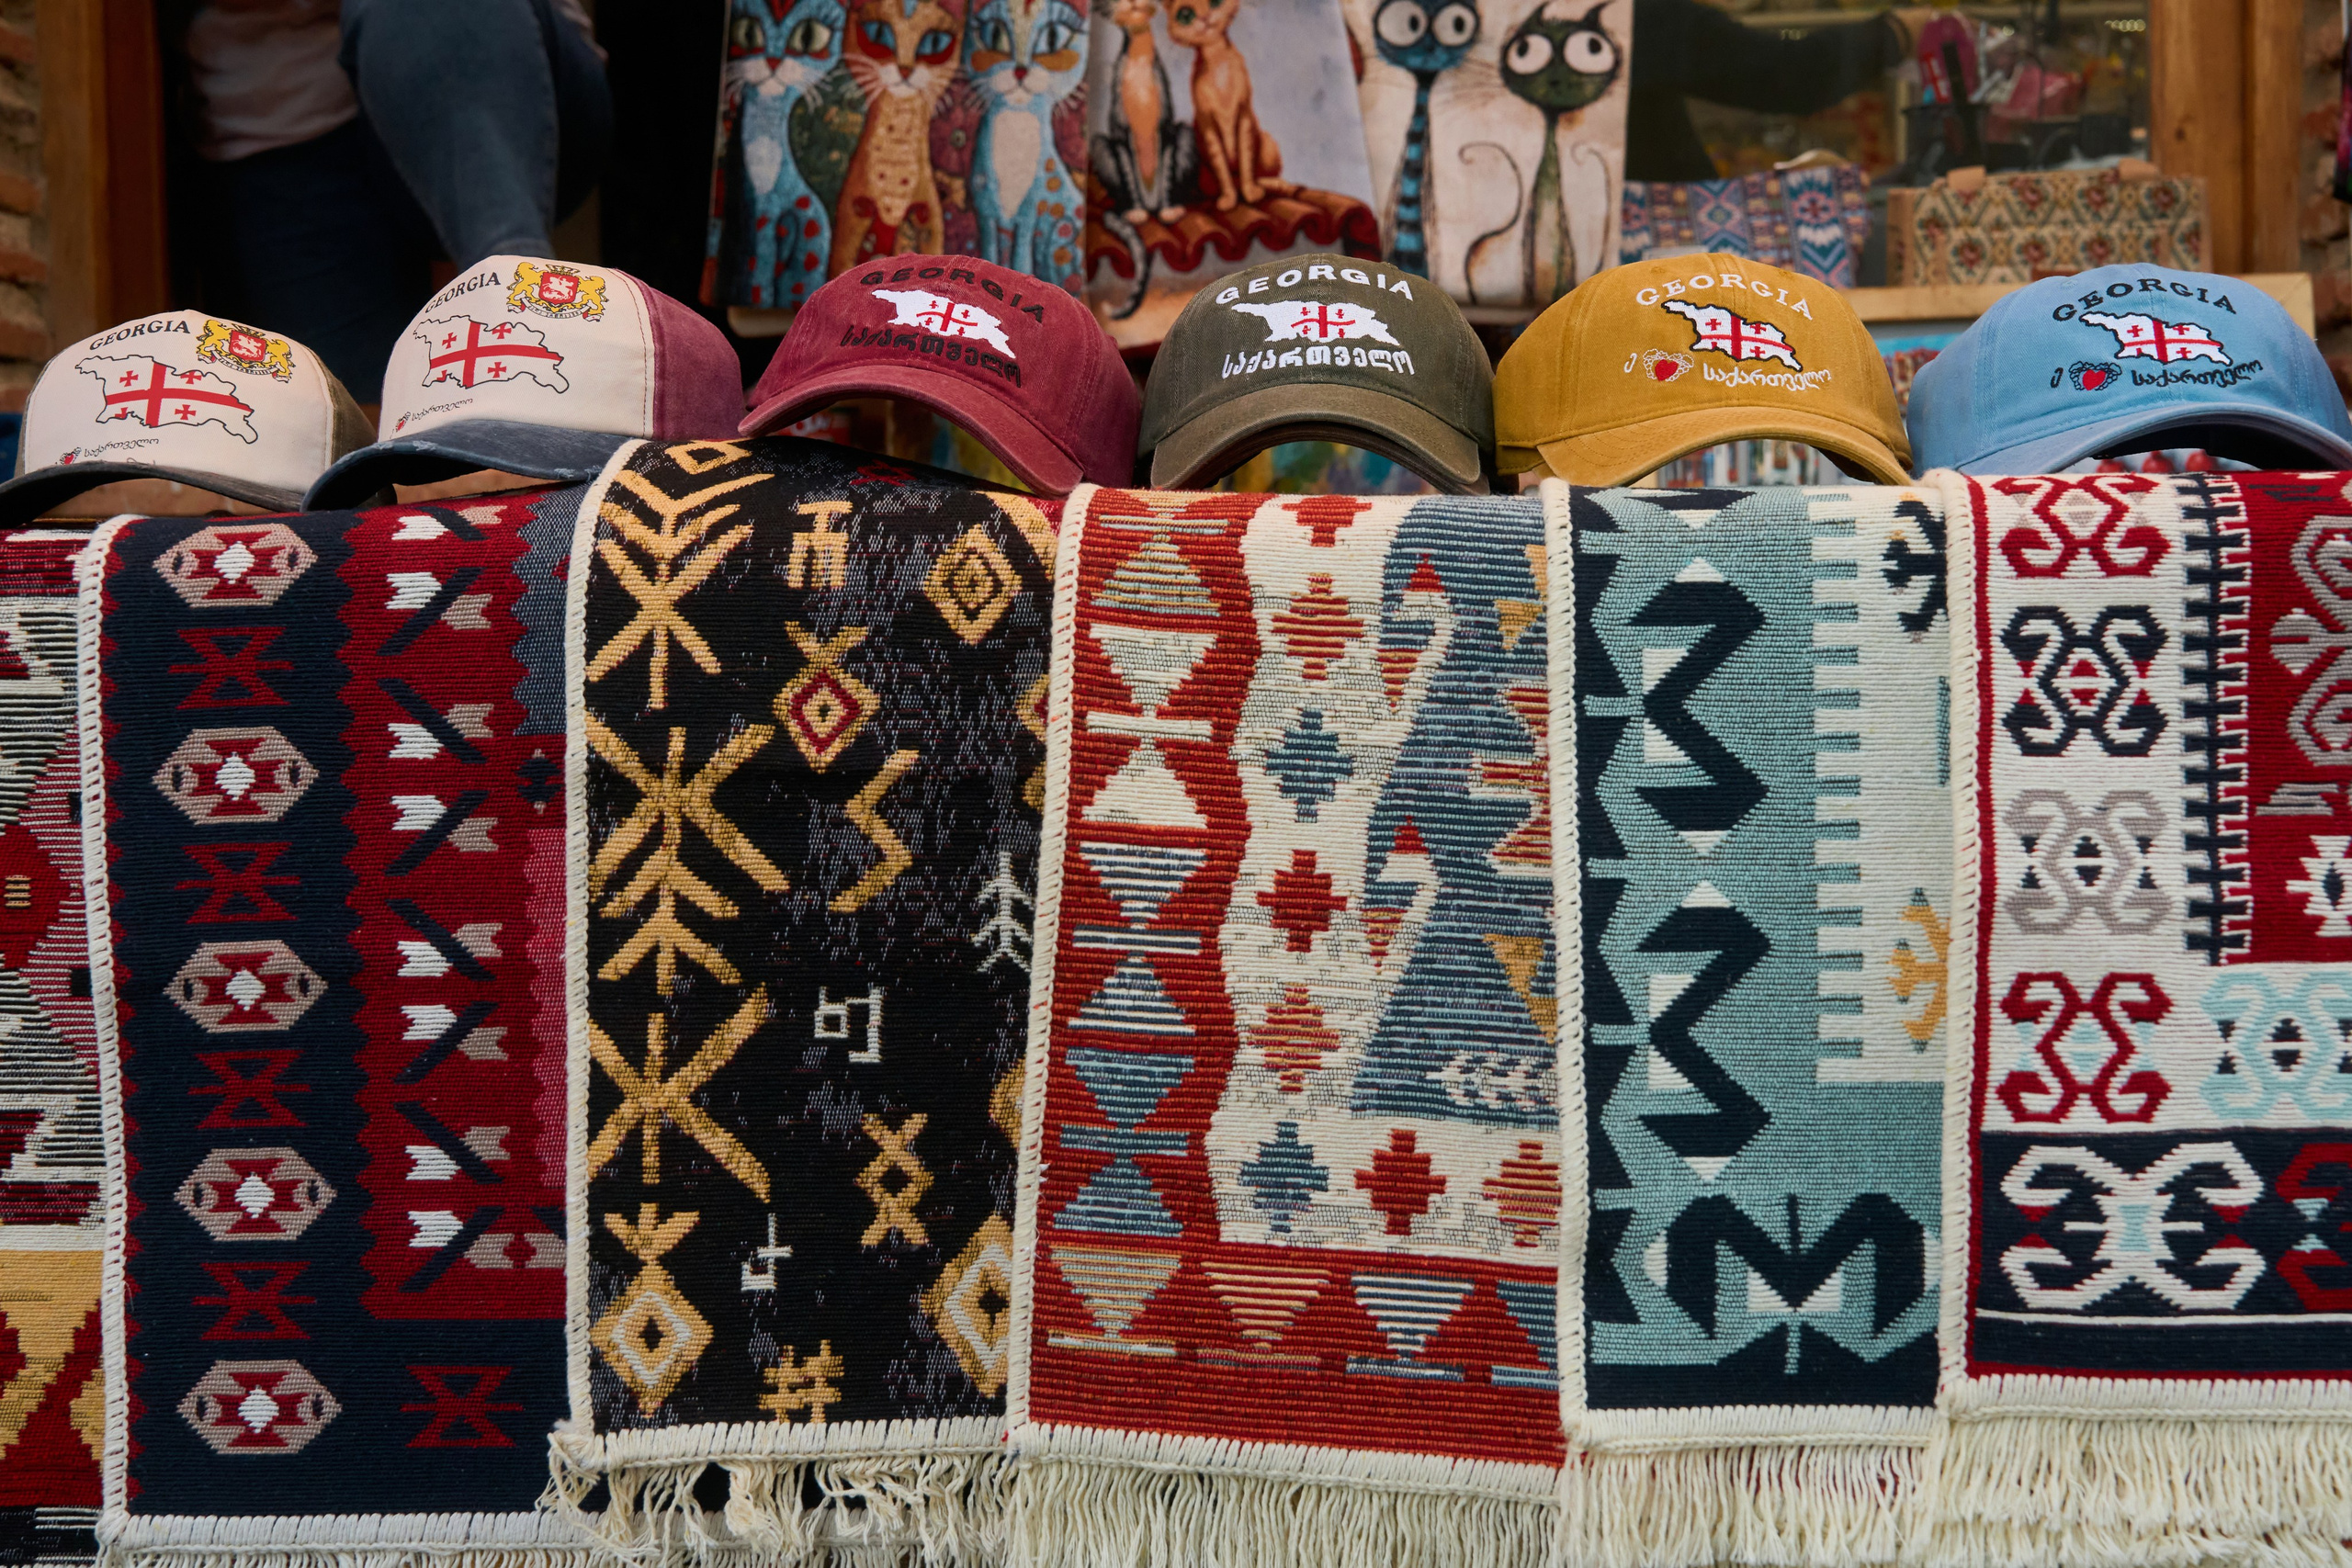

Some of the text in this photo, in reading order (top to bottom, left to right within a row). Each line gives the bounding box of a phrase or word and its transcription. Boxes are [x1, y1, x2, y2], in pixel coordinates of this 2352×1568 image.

[424, 272, 502, 314] GEORGIA
[860, 266, 1046, 323] GEORGIA
[1216, 265, 1414, 305] GEORGIA
[1635, 273, 1814, 321] GEORGIA
[2052, 277, 2237, 321] GEORGIA
[89, 320, 191, 351] GEORGIA
[1221, 345, 1415, 379] საქართველო
[1702, 363, 1832, 391] საქართველო
[2131, 359, 2264, 389] საქართველო
